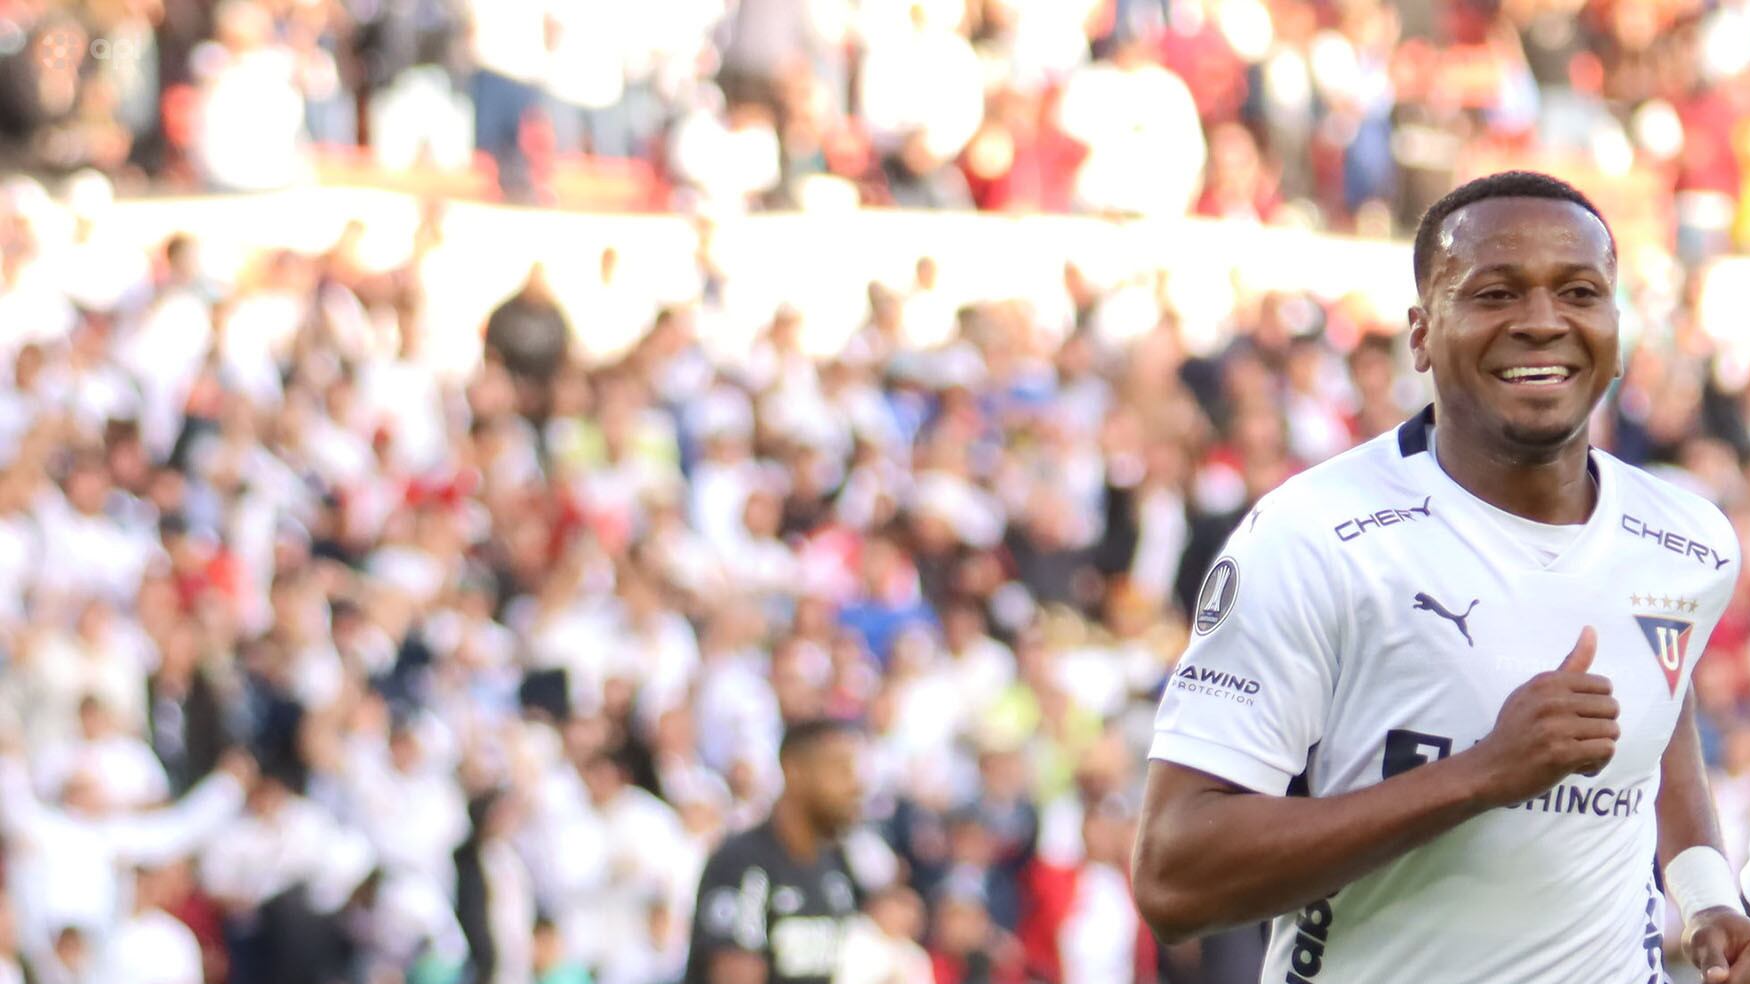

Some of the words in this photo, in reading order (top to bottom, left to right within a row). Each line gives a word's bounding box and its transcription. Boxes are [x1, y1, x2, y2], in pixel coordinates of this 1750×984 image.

[1334, 495, 1431, 542] CHERY
[1622, 513, 1730, 571] CHERY
[1656, 626, 1680, 671] U
